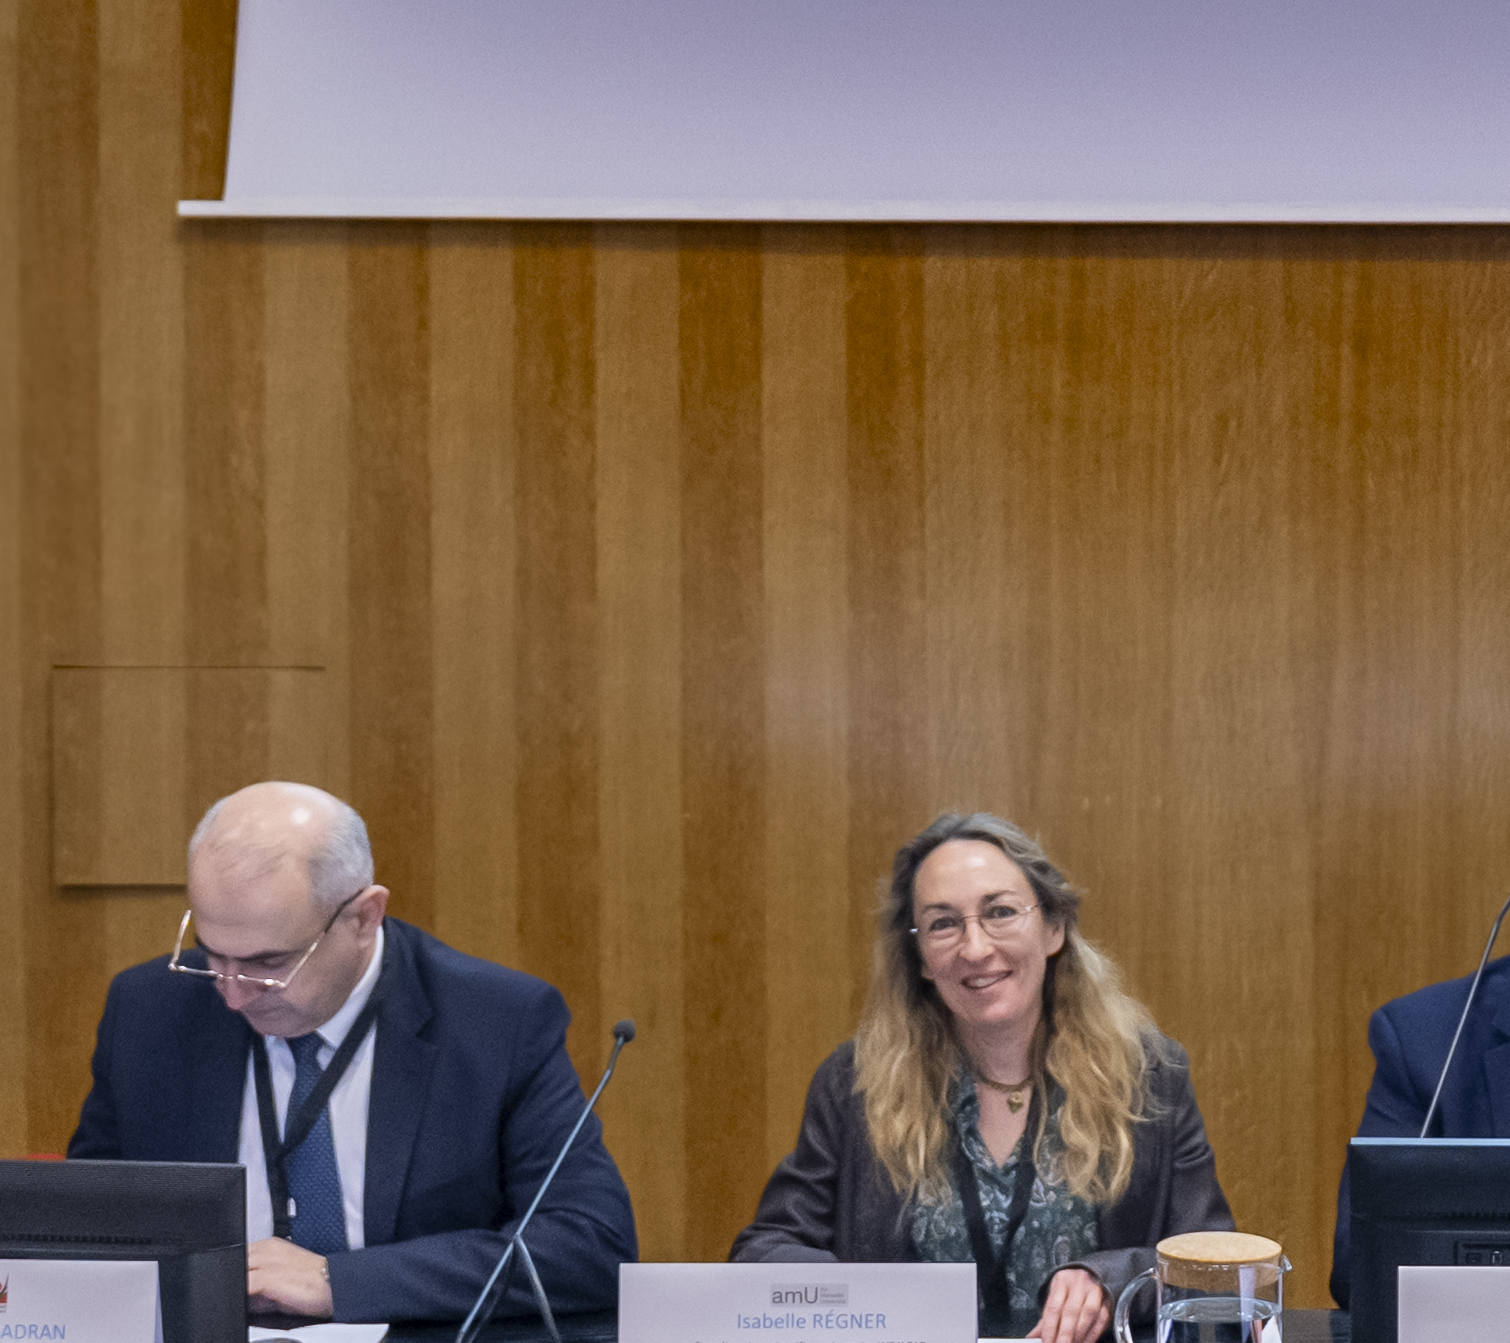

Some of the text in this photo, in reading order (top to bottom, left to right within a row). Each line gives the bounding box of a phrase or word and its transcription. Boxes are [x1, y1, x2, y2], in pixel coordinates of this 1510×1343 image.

[772, 1286, 819, 1305] amU
[737, 1310, 887, 1330] Isabelle RÉGNER
